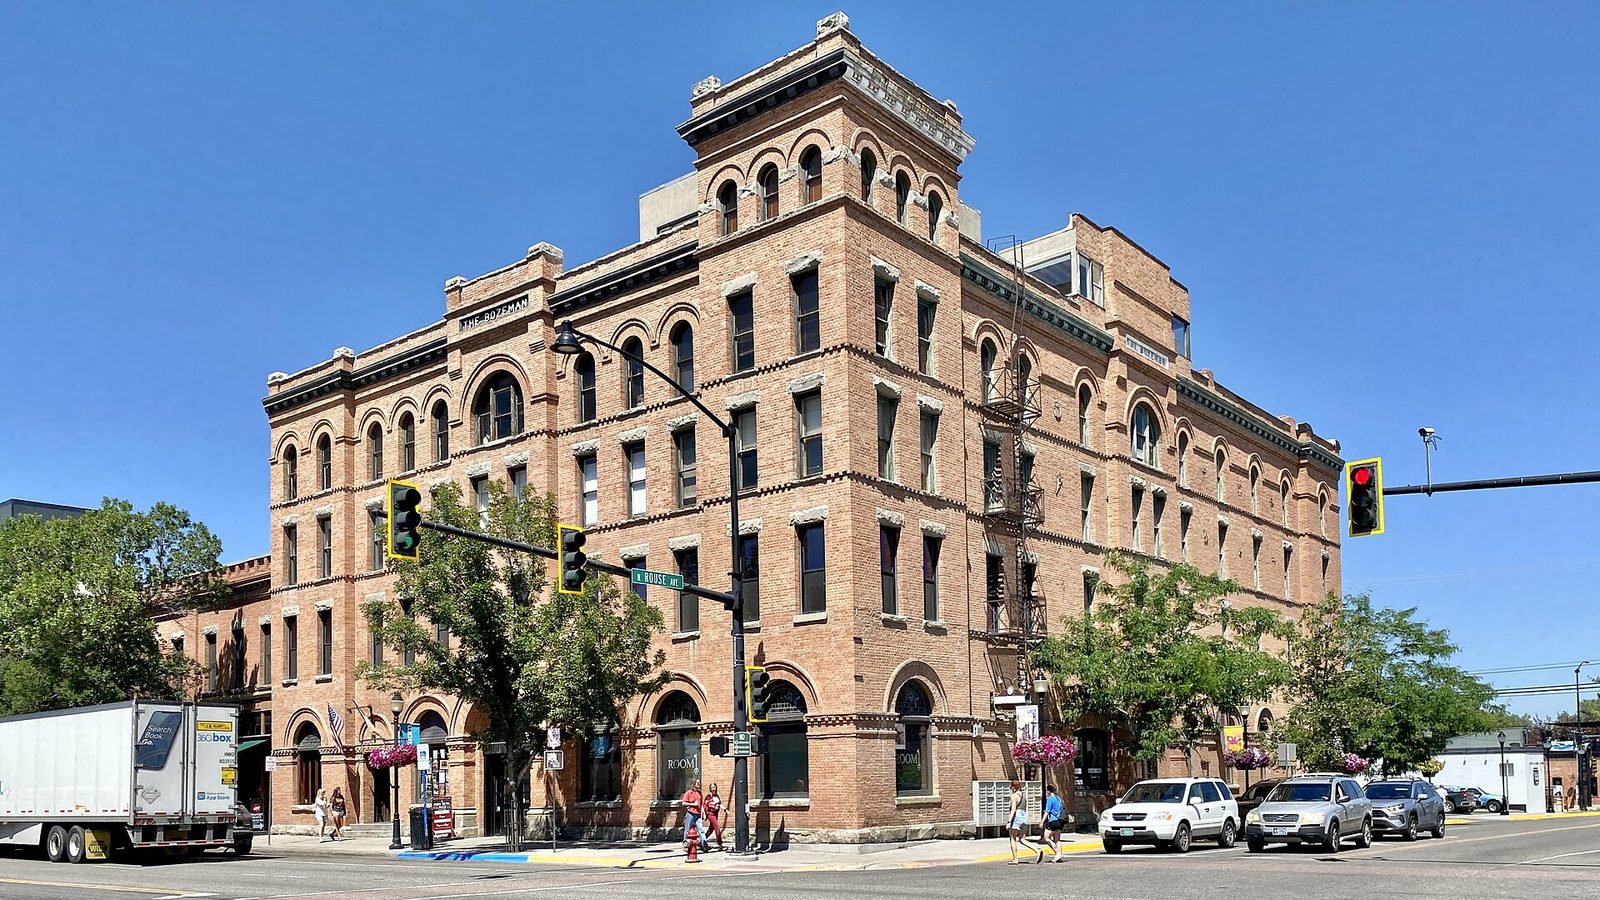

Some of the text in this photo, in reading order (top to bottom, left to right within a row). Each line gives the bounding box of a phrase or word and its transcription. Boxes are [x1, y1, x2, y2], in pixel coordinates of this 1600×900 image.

[463, 298, 528, 331] THE BOZEMAN
[636, 572, 679, 587] N ROUSE AVE
